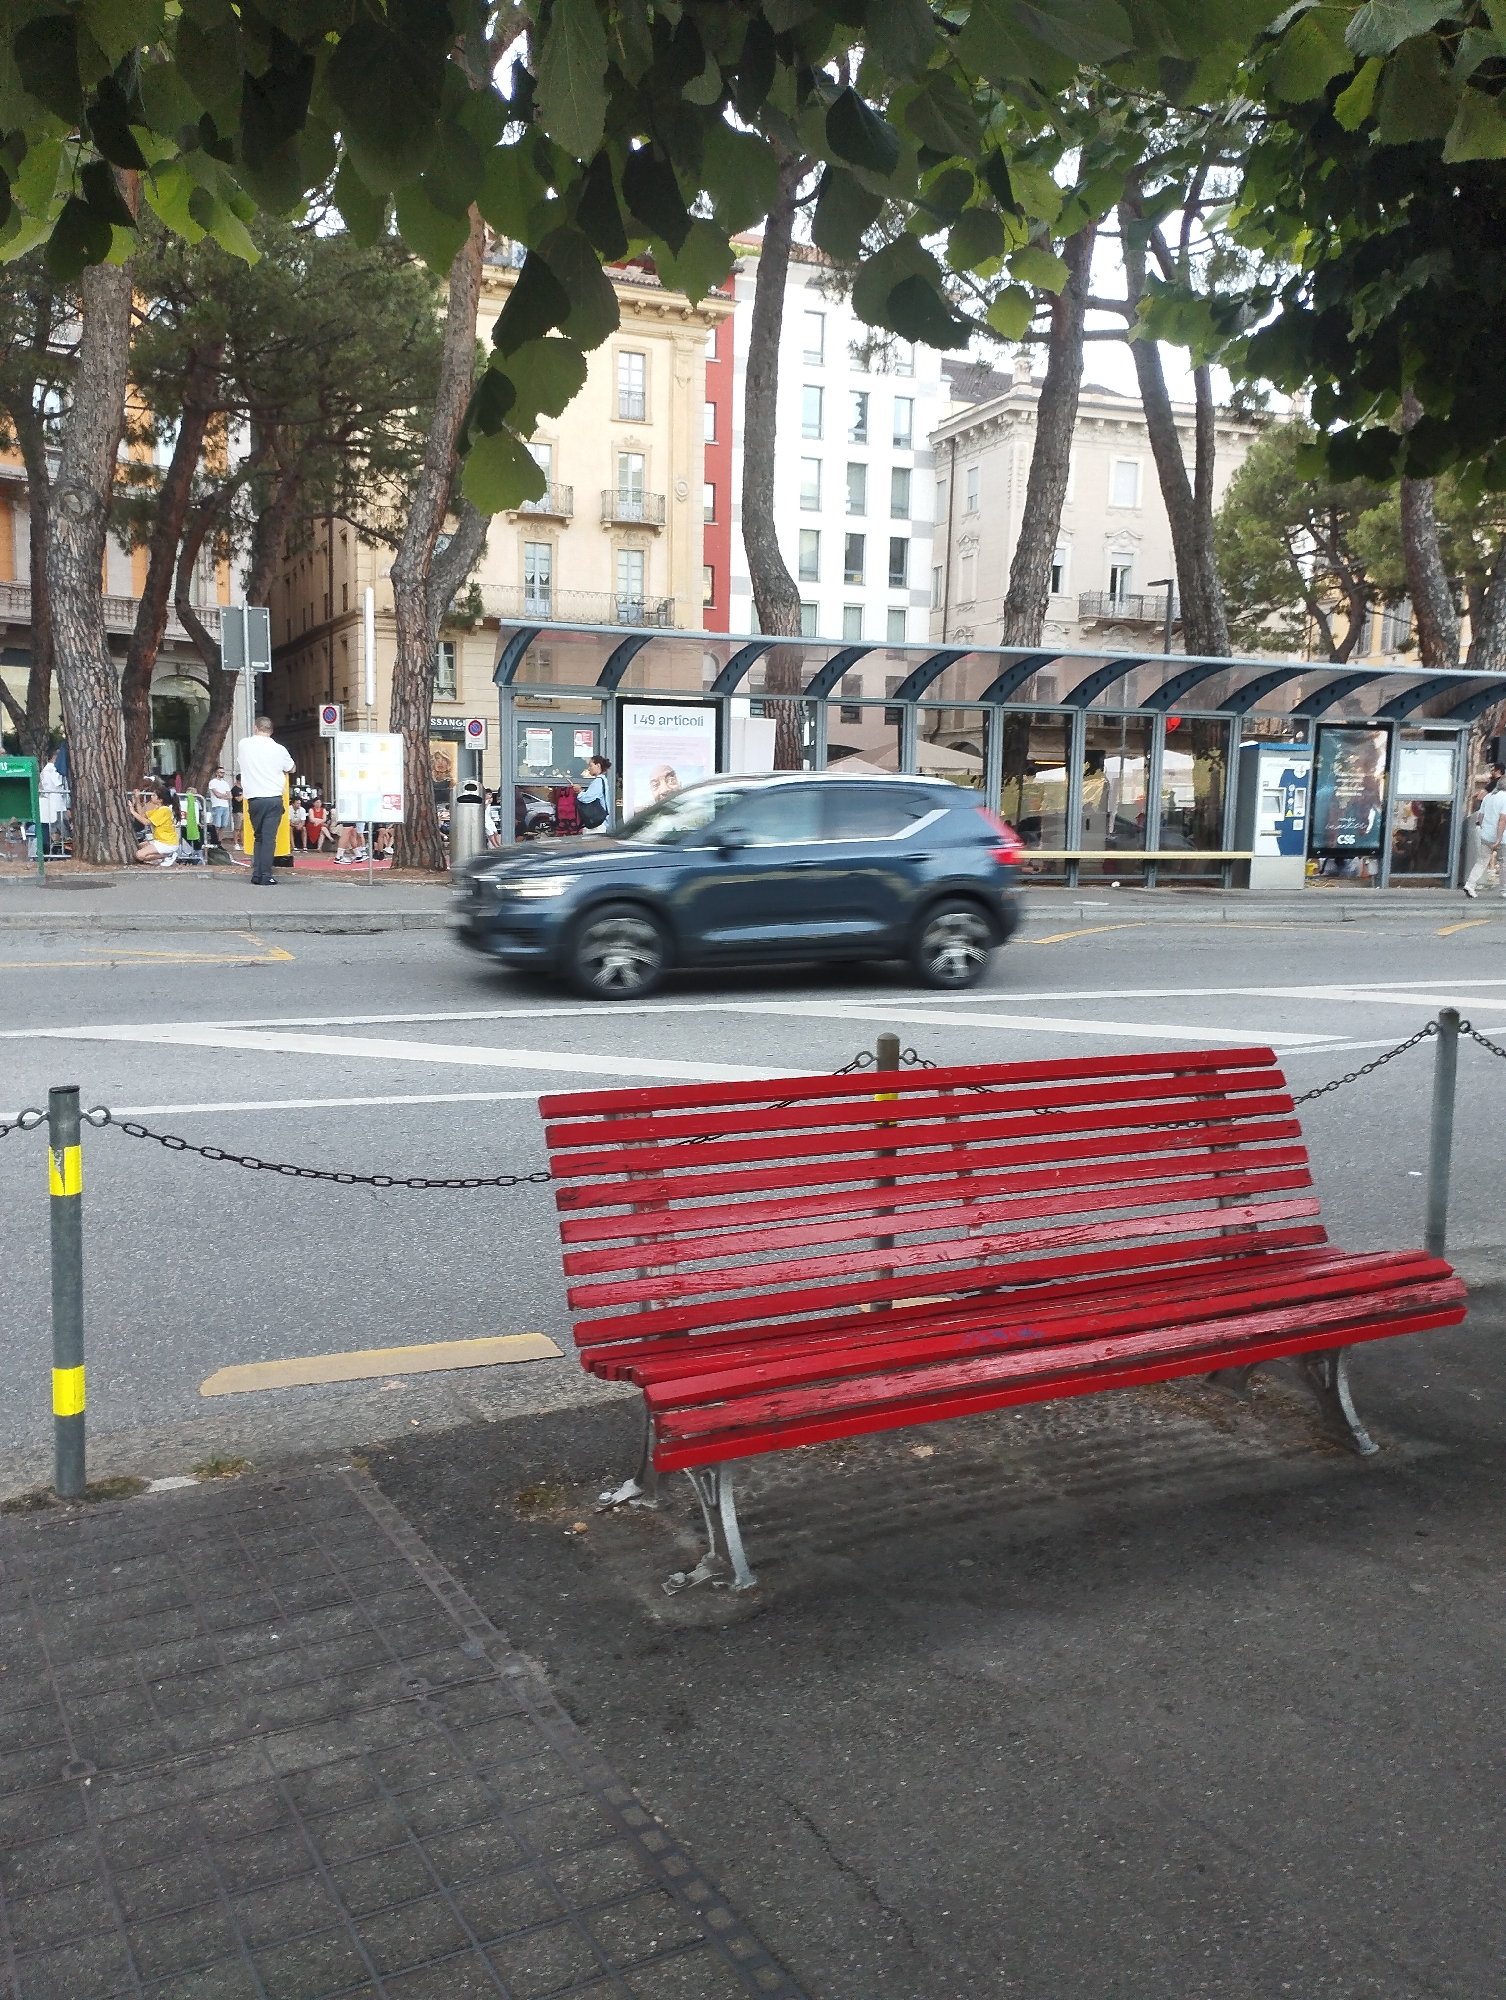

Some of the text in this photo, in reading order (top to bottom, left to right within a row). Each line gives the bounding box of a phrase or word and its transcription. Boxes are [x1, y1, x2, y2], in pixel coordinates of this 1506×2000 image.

[633, 714, 704, 727] I 49 articoli
